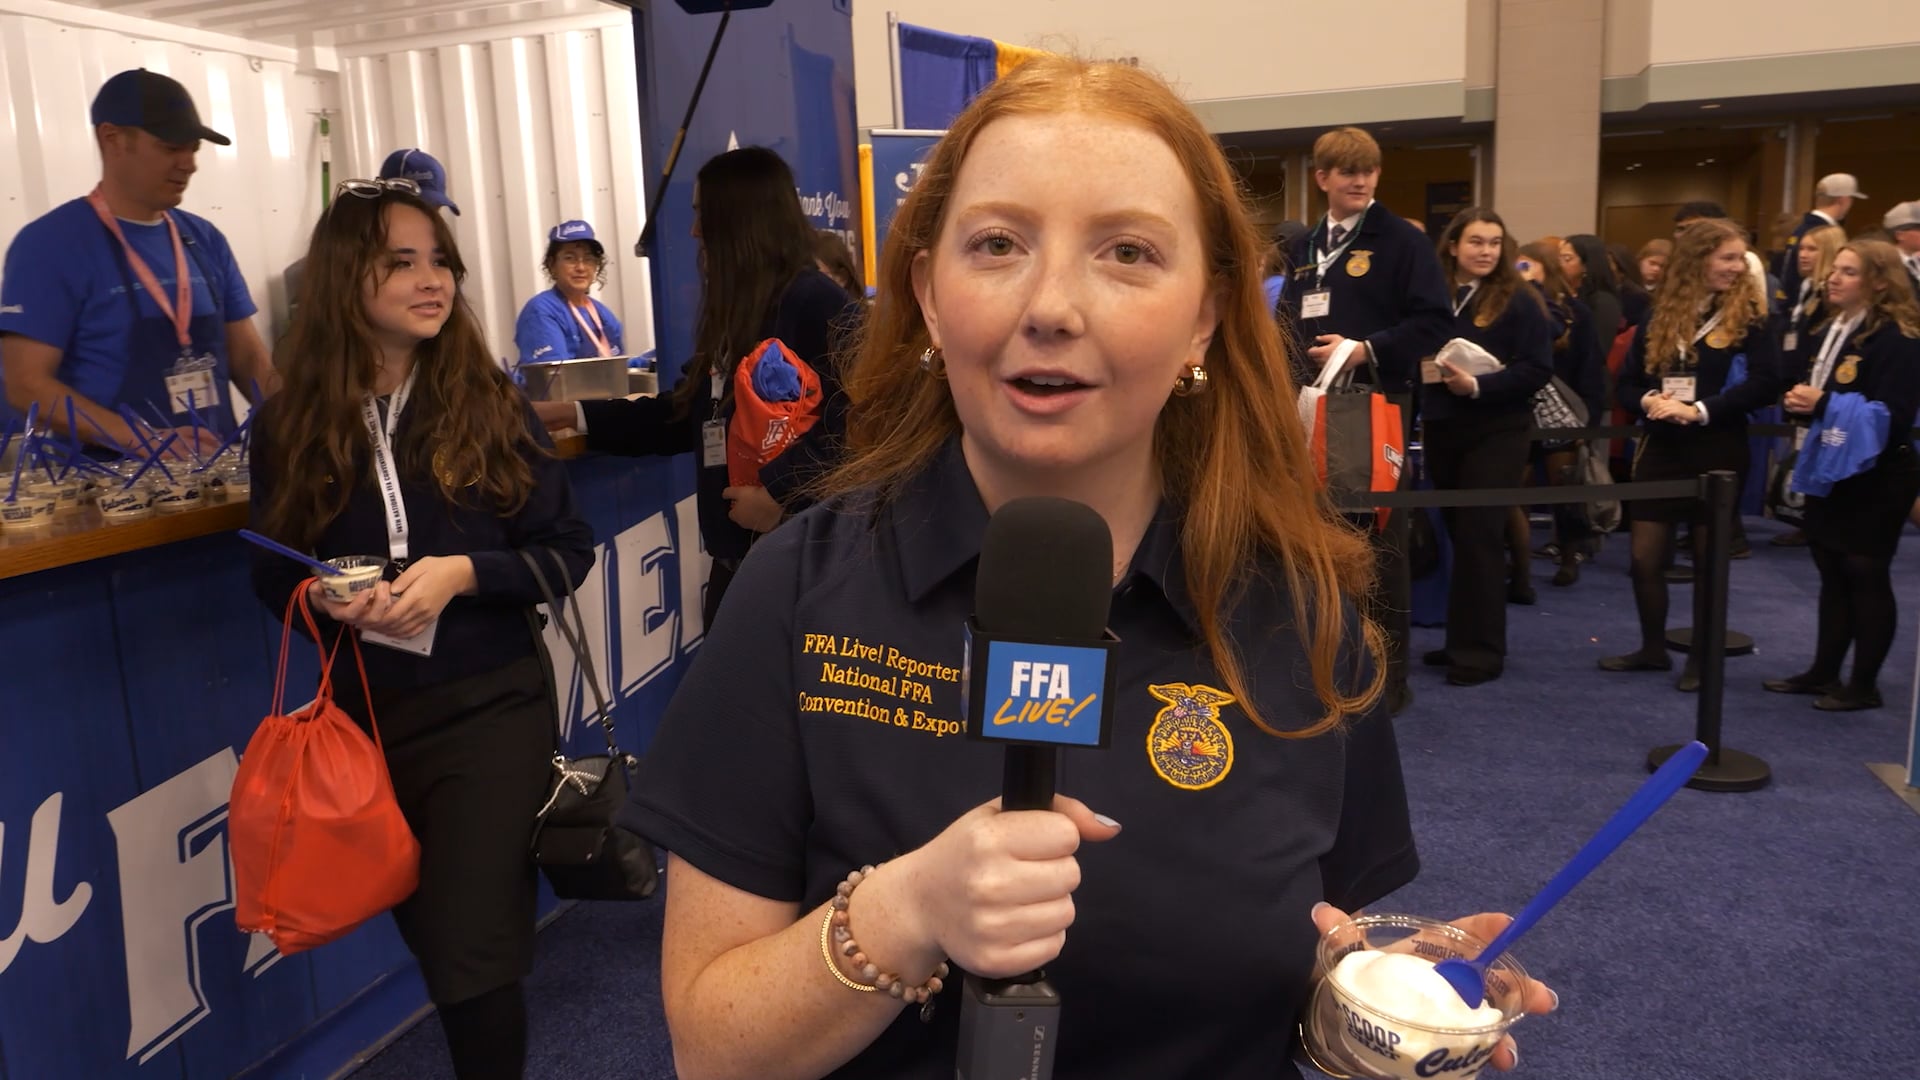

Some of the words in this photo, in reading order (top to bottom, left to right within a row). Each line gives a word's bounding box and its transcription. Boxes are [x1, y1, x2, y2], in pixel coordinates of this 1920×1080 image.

[803, 633, 837, 655] FFA
[840, 636, 884, 664] Live!
[886, 647, 961, 683] Reporter
[1011, 661, 1070, 699] FFA
[820, 662, 897, 697] National
[899, 680, 934, 704] FFA
[799, 691, 890, 724] Convention
[894, 707, 909, 728] &
[912, 710, 960, 738] Expo
[993, 693, 1097, 727] LIVE!
[1342, 1003, 1401, 1051] SCOOP
